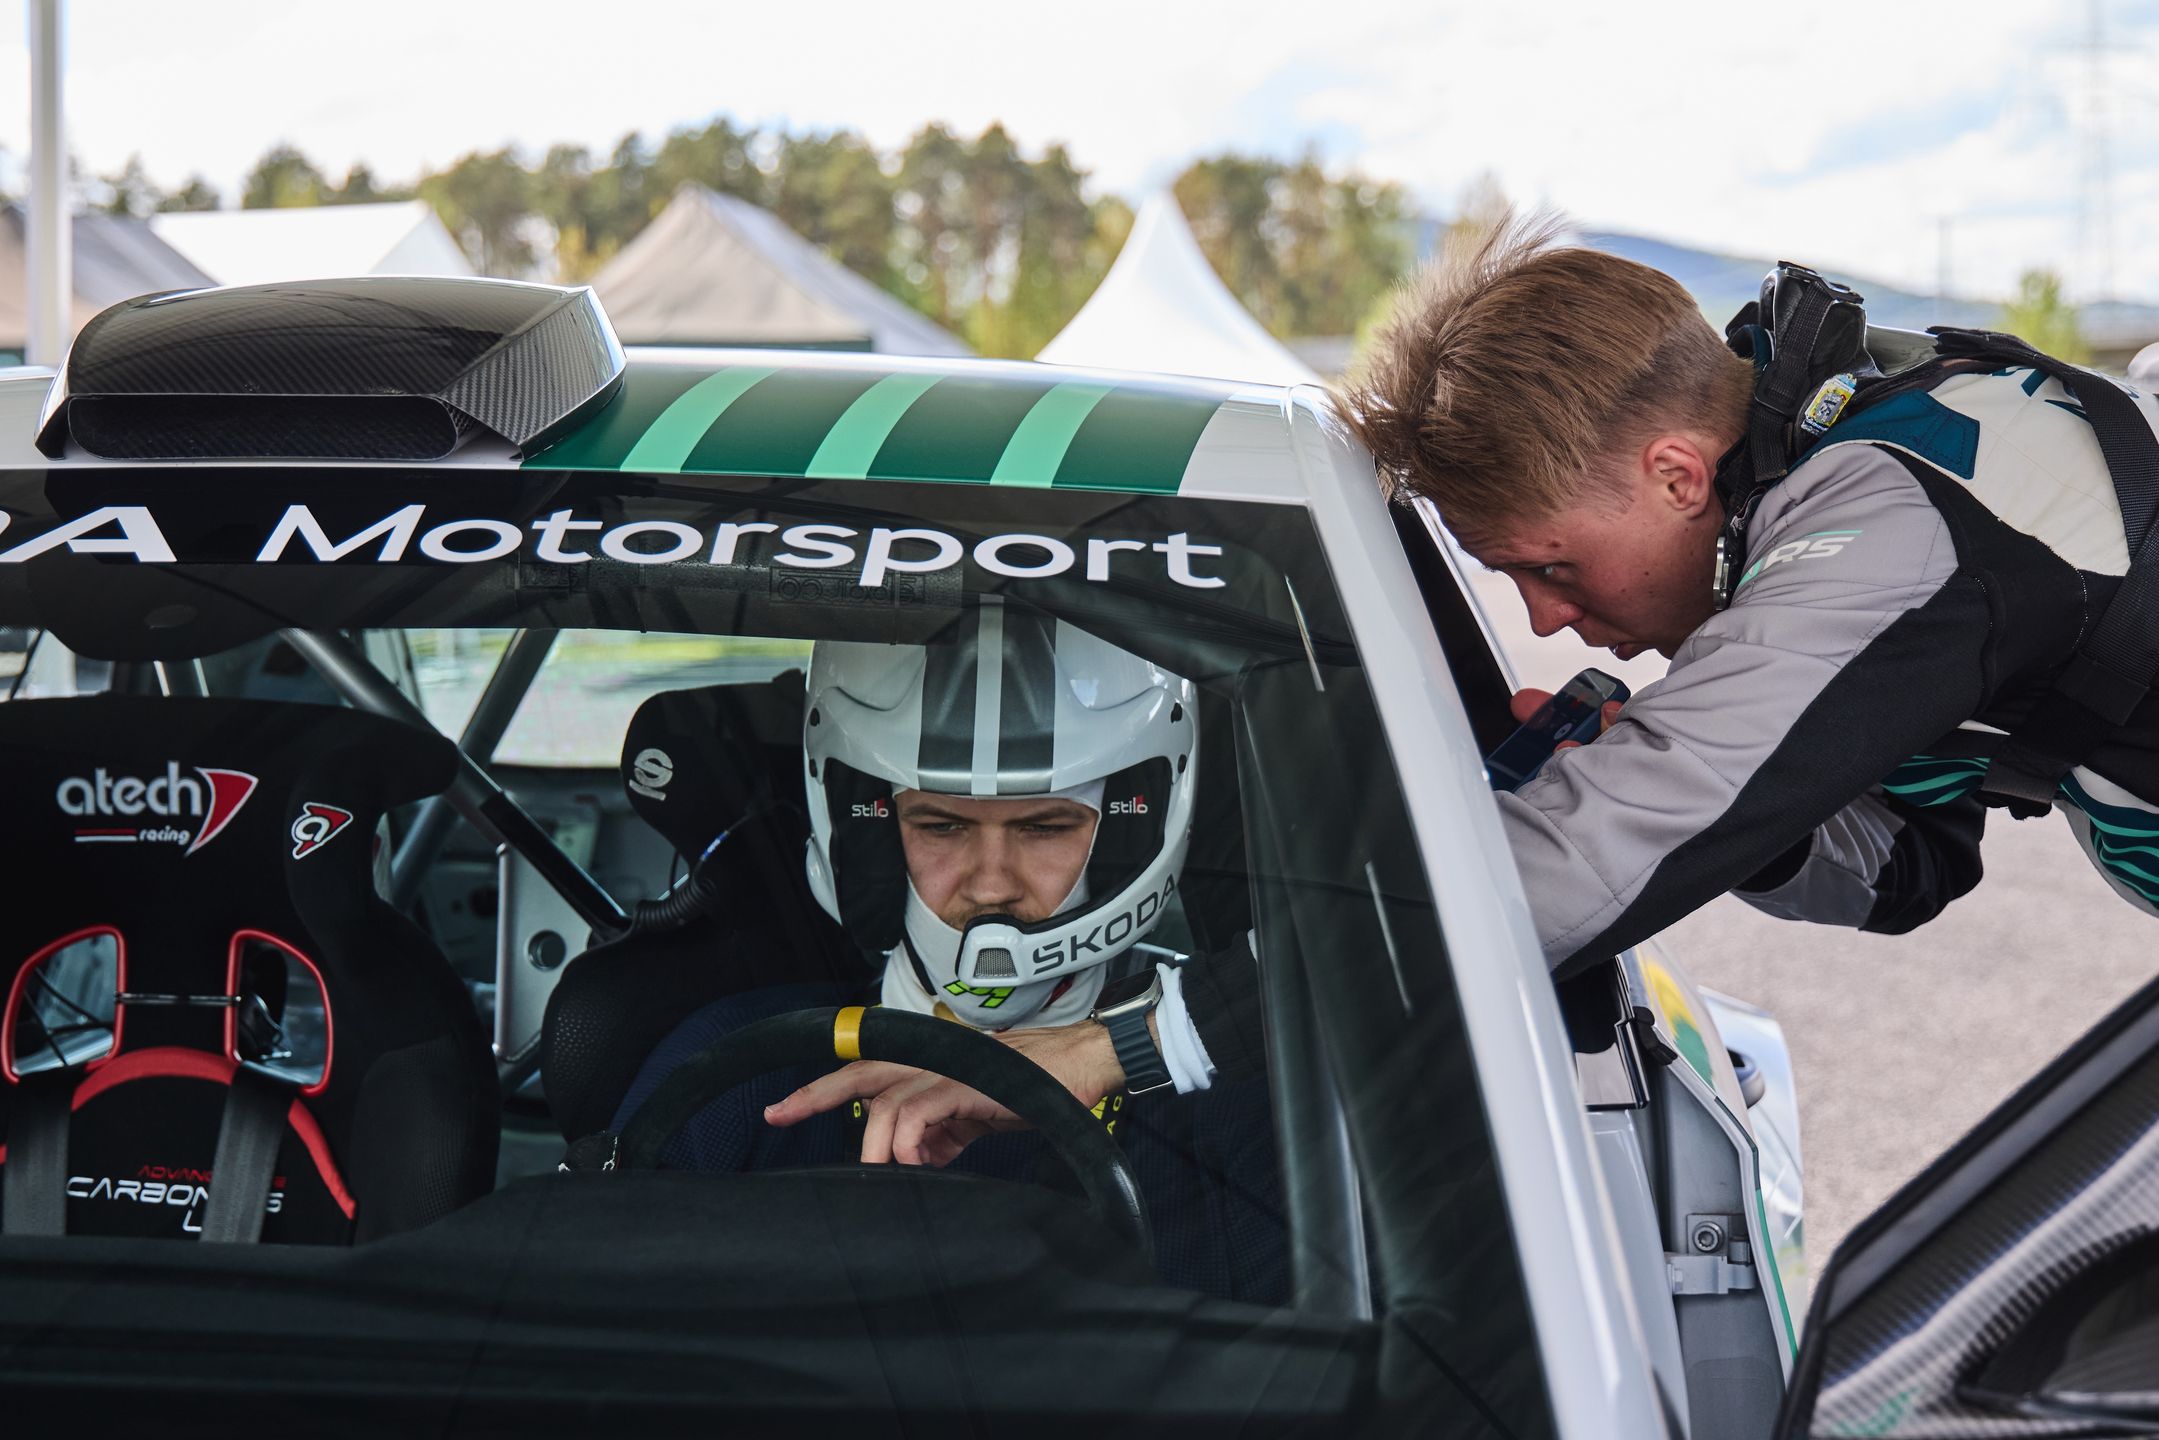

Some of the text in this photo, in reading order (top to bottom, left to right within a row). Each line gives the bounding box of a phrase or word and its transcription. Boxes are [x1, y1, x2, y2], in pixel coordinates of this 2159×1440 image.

[0, 504, 1226, 588] A Motorsport
[56, 760, 203, 816] atech
[139, 825, 191, 846] racing
[1032, 873, 1176, 976] SKODA
